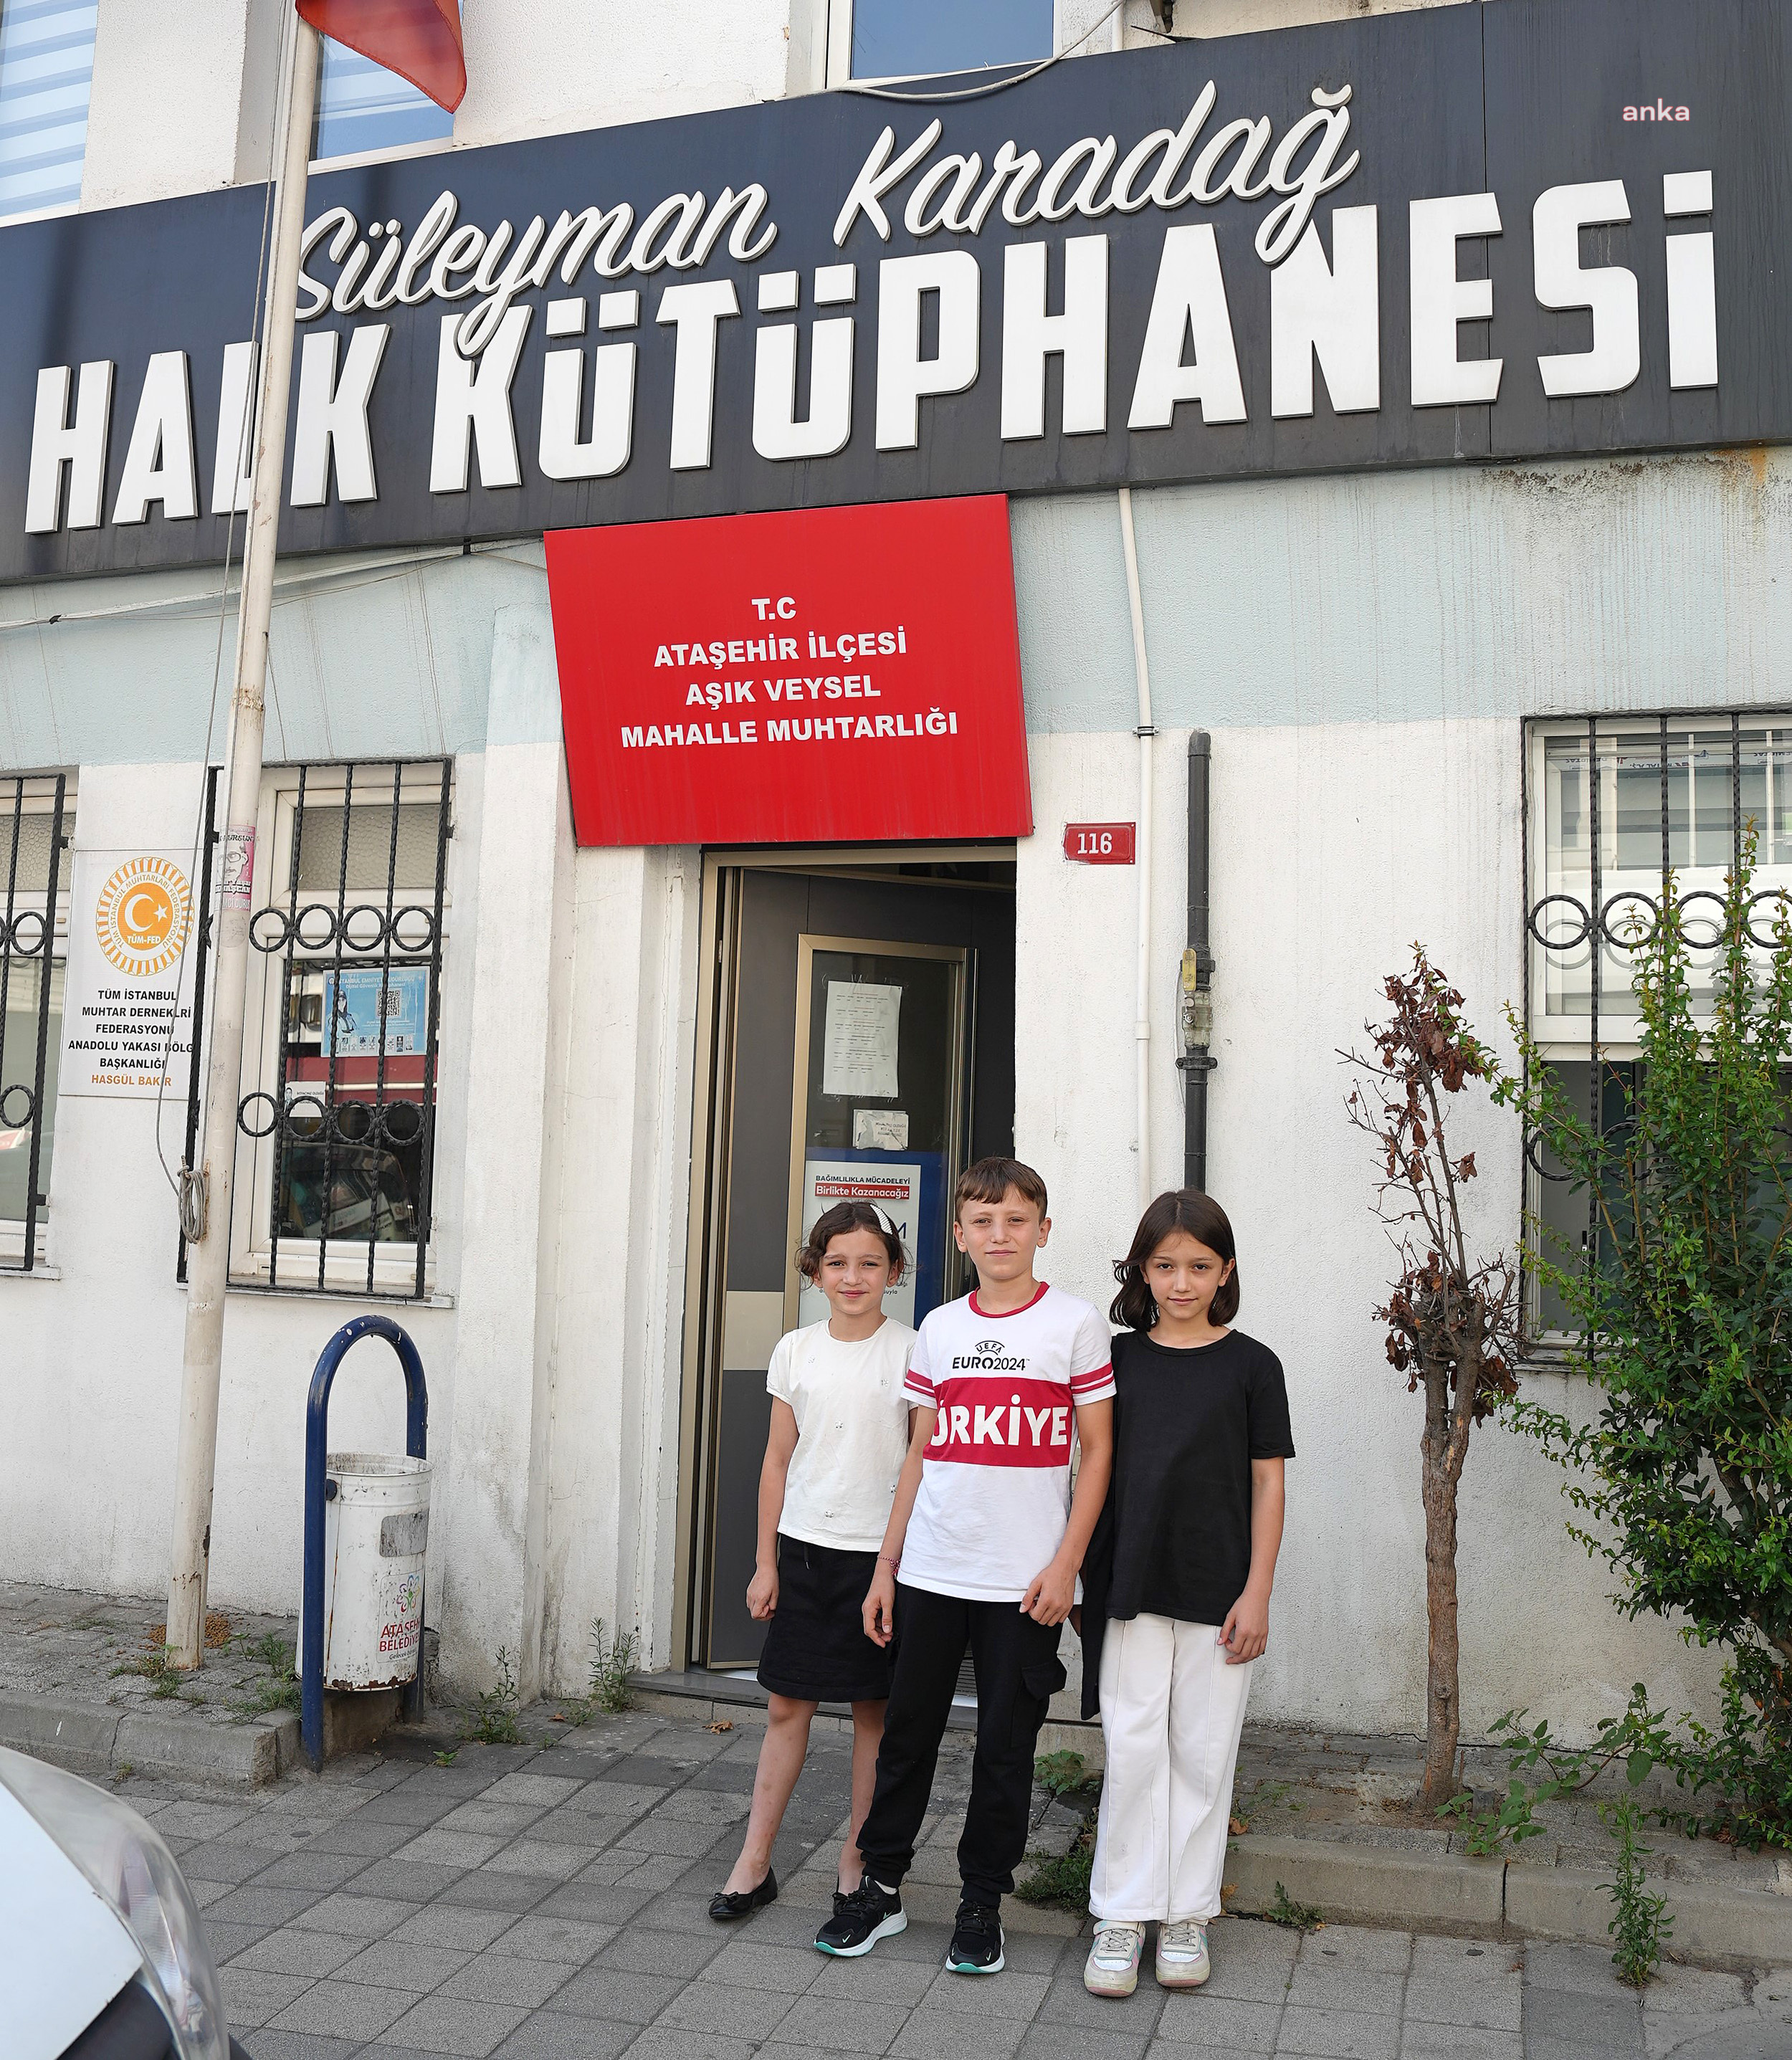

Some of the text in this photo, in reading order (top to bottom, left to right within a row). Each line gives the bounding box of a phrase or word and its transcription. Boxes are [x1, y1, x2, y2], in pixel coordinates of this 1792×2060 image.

[295, 80, 1360, 356] Süleyman Karadağ
[24, 170, 1719, 534] HALK KÜTÜPHANESİ
[751, 596, 796, 621] T.C
[654, 626, 907, 670] ATAŞEHİR İLÇESİ
[685, 674, 882, 710] AŞIK VEYSEL
[621, 707, 958, 748] MAHALLE MUHTARLIĞI
[1077, 832, 1112, 854] 116
[162, 888, 181, 949] FEDERASYONU
[127, 933, 161, 944] TÜM-FED
[98, 988, 177, 1001] TÜM İSTANBUL
[82, 1006, 127, 1017] MUHTAR
[96, 1024, 174, 1035] FEDERASYONU
[68, 1040, 193, 1053] ANADOLU YAKASI BÖLG
[100, 1058, 166, 1070] BAŞKANLIĞI
[92, 1074, 172, 1087] HASGÜL BAKR
[816, 1174, 910, 1185] BAĞIMLILIKLA MÜCADELEYİ
[816, 1186, 909, 1198] Birlikte Kazanacağız
[976, 1343, 1002, 1353] UEFA
